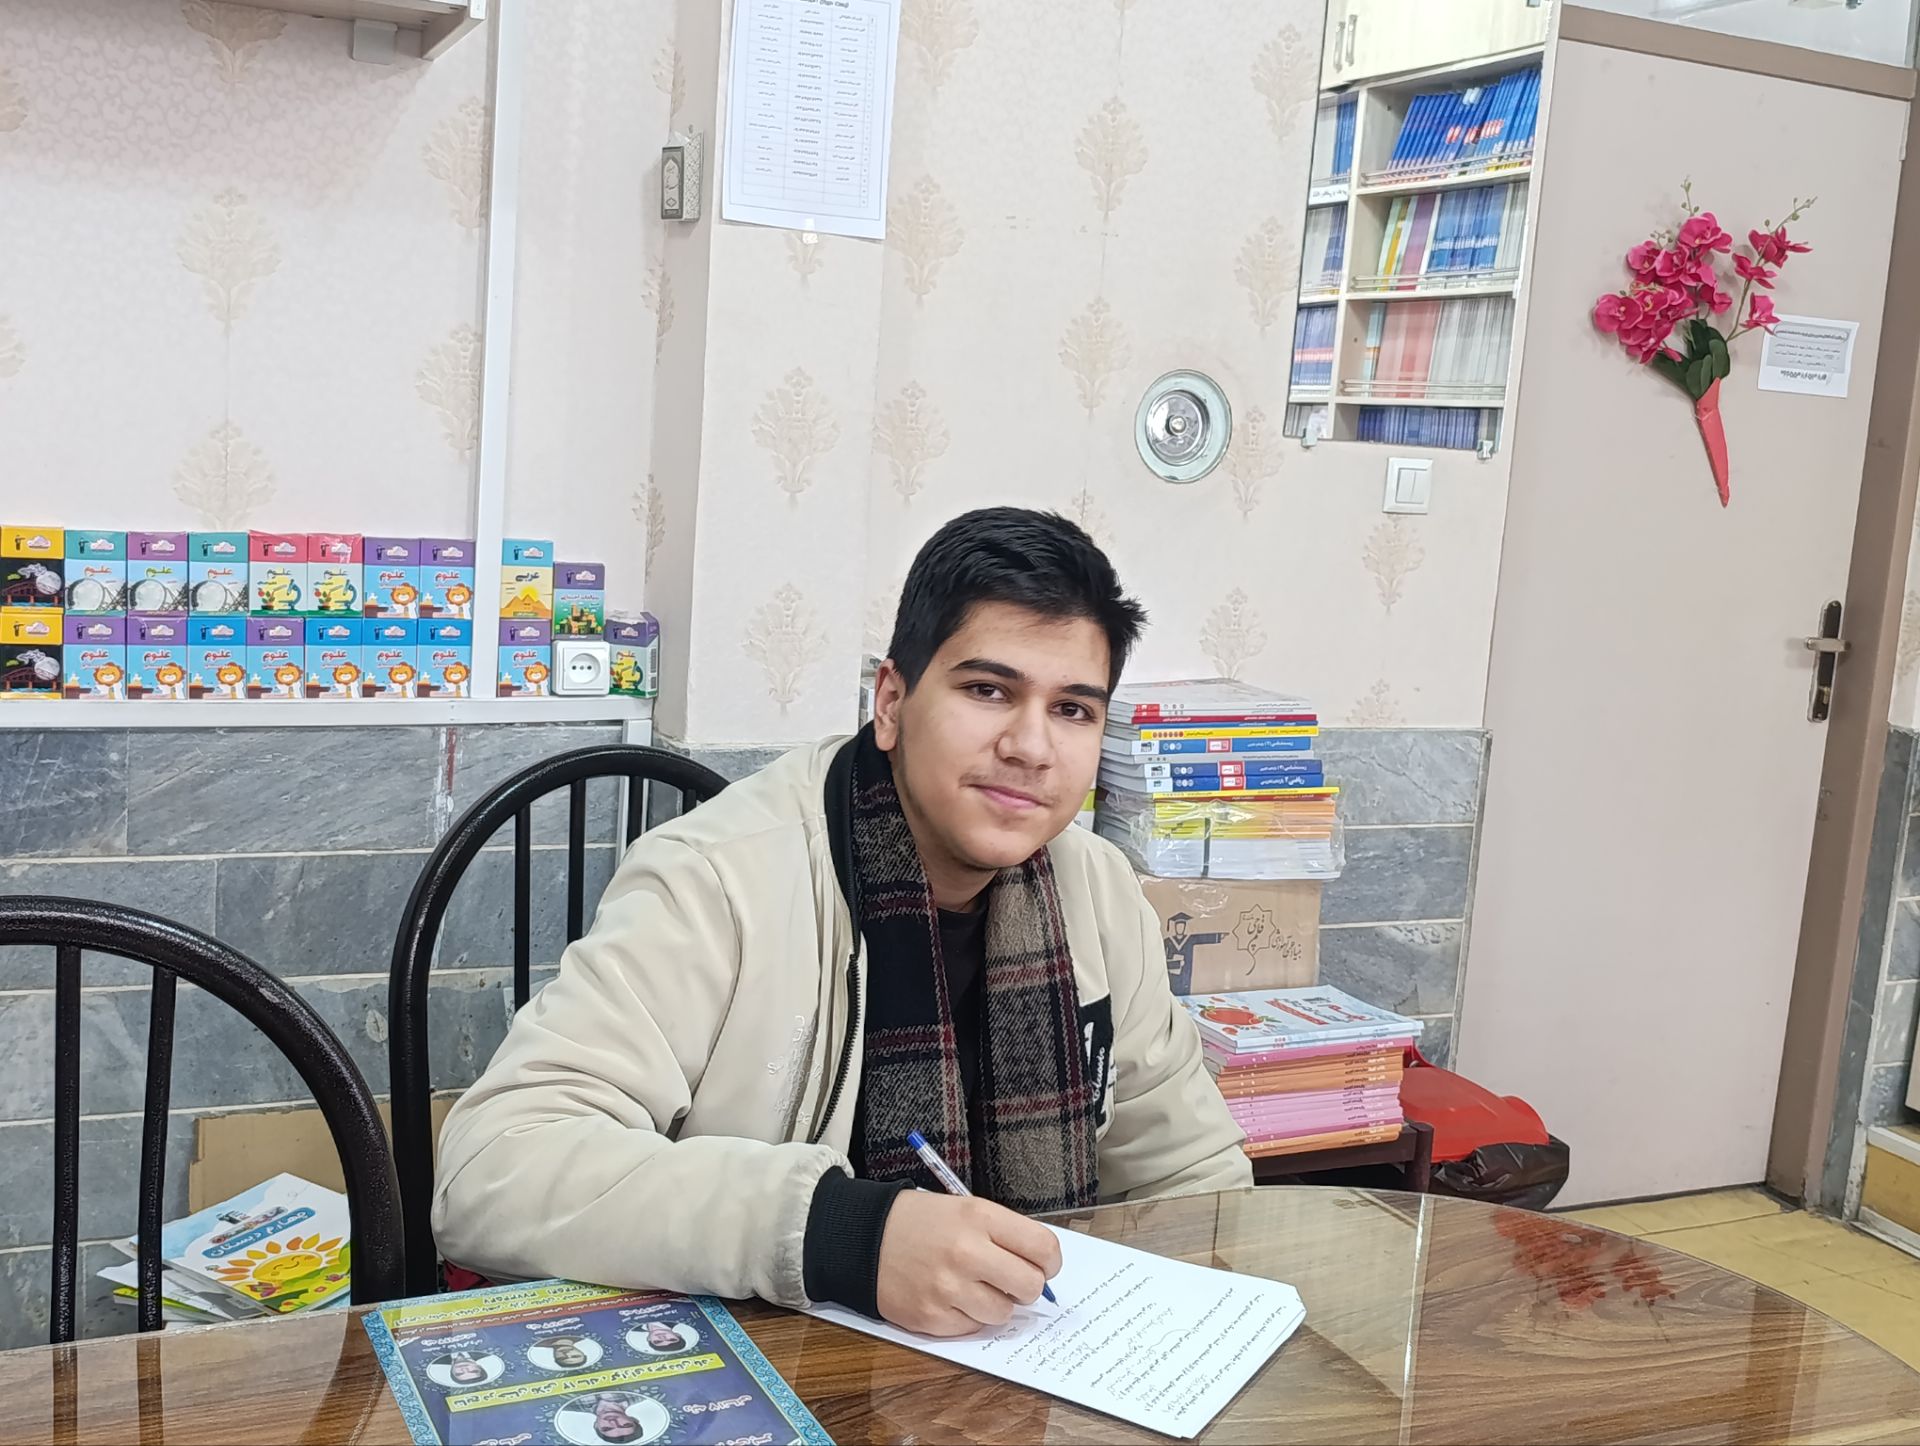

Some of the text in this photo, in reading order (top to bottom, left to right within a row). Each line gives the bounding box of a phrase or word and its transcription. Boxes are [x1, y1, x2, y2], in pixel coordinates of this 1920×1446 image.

[379, 570, 405, 581] علوم
[435, 570, 460, 581] علوم
[515, 571, 540, 581] عربی
[81, 649, 109, 661] علوم
[143, 649, 171, 661] علوم
[204, 649, 231, 661] علوم
[262, 649, 288, 661] علوم
[321, 649, 347, 661] علوم
[377, 649, 402, 661] علوم
[432, 649, 457, 661] علوم
[513, 649, 537, 660] علوم
[211, 1231, 262, 1257] دبستان
[454, 1396, 480, 1407] نتایج
[483, 1388, 529, 1402] درخشان
[531, 1382, 557, 1394] تلاش
[563, 1381, 576, 1389] ۱۲
[577, 1377, 599, 1386] ساله
[610, 1367, 646, 1381] گوارای
[647, 1360, 691, 1373] وجودتان
[682, 1403, 707, 1416] رتبه
